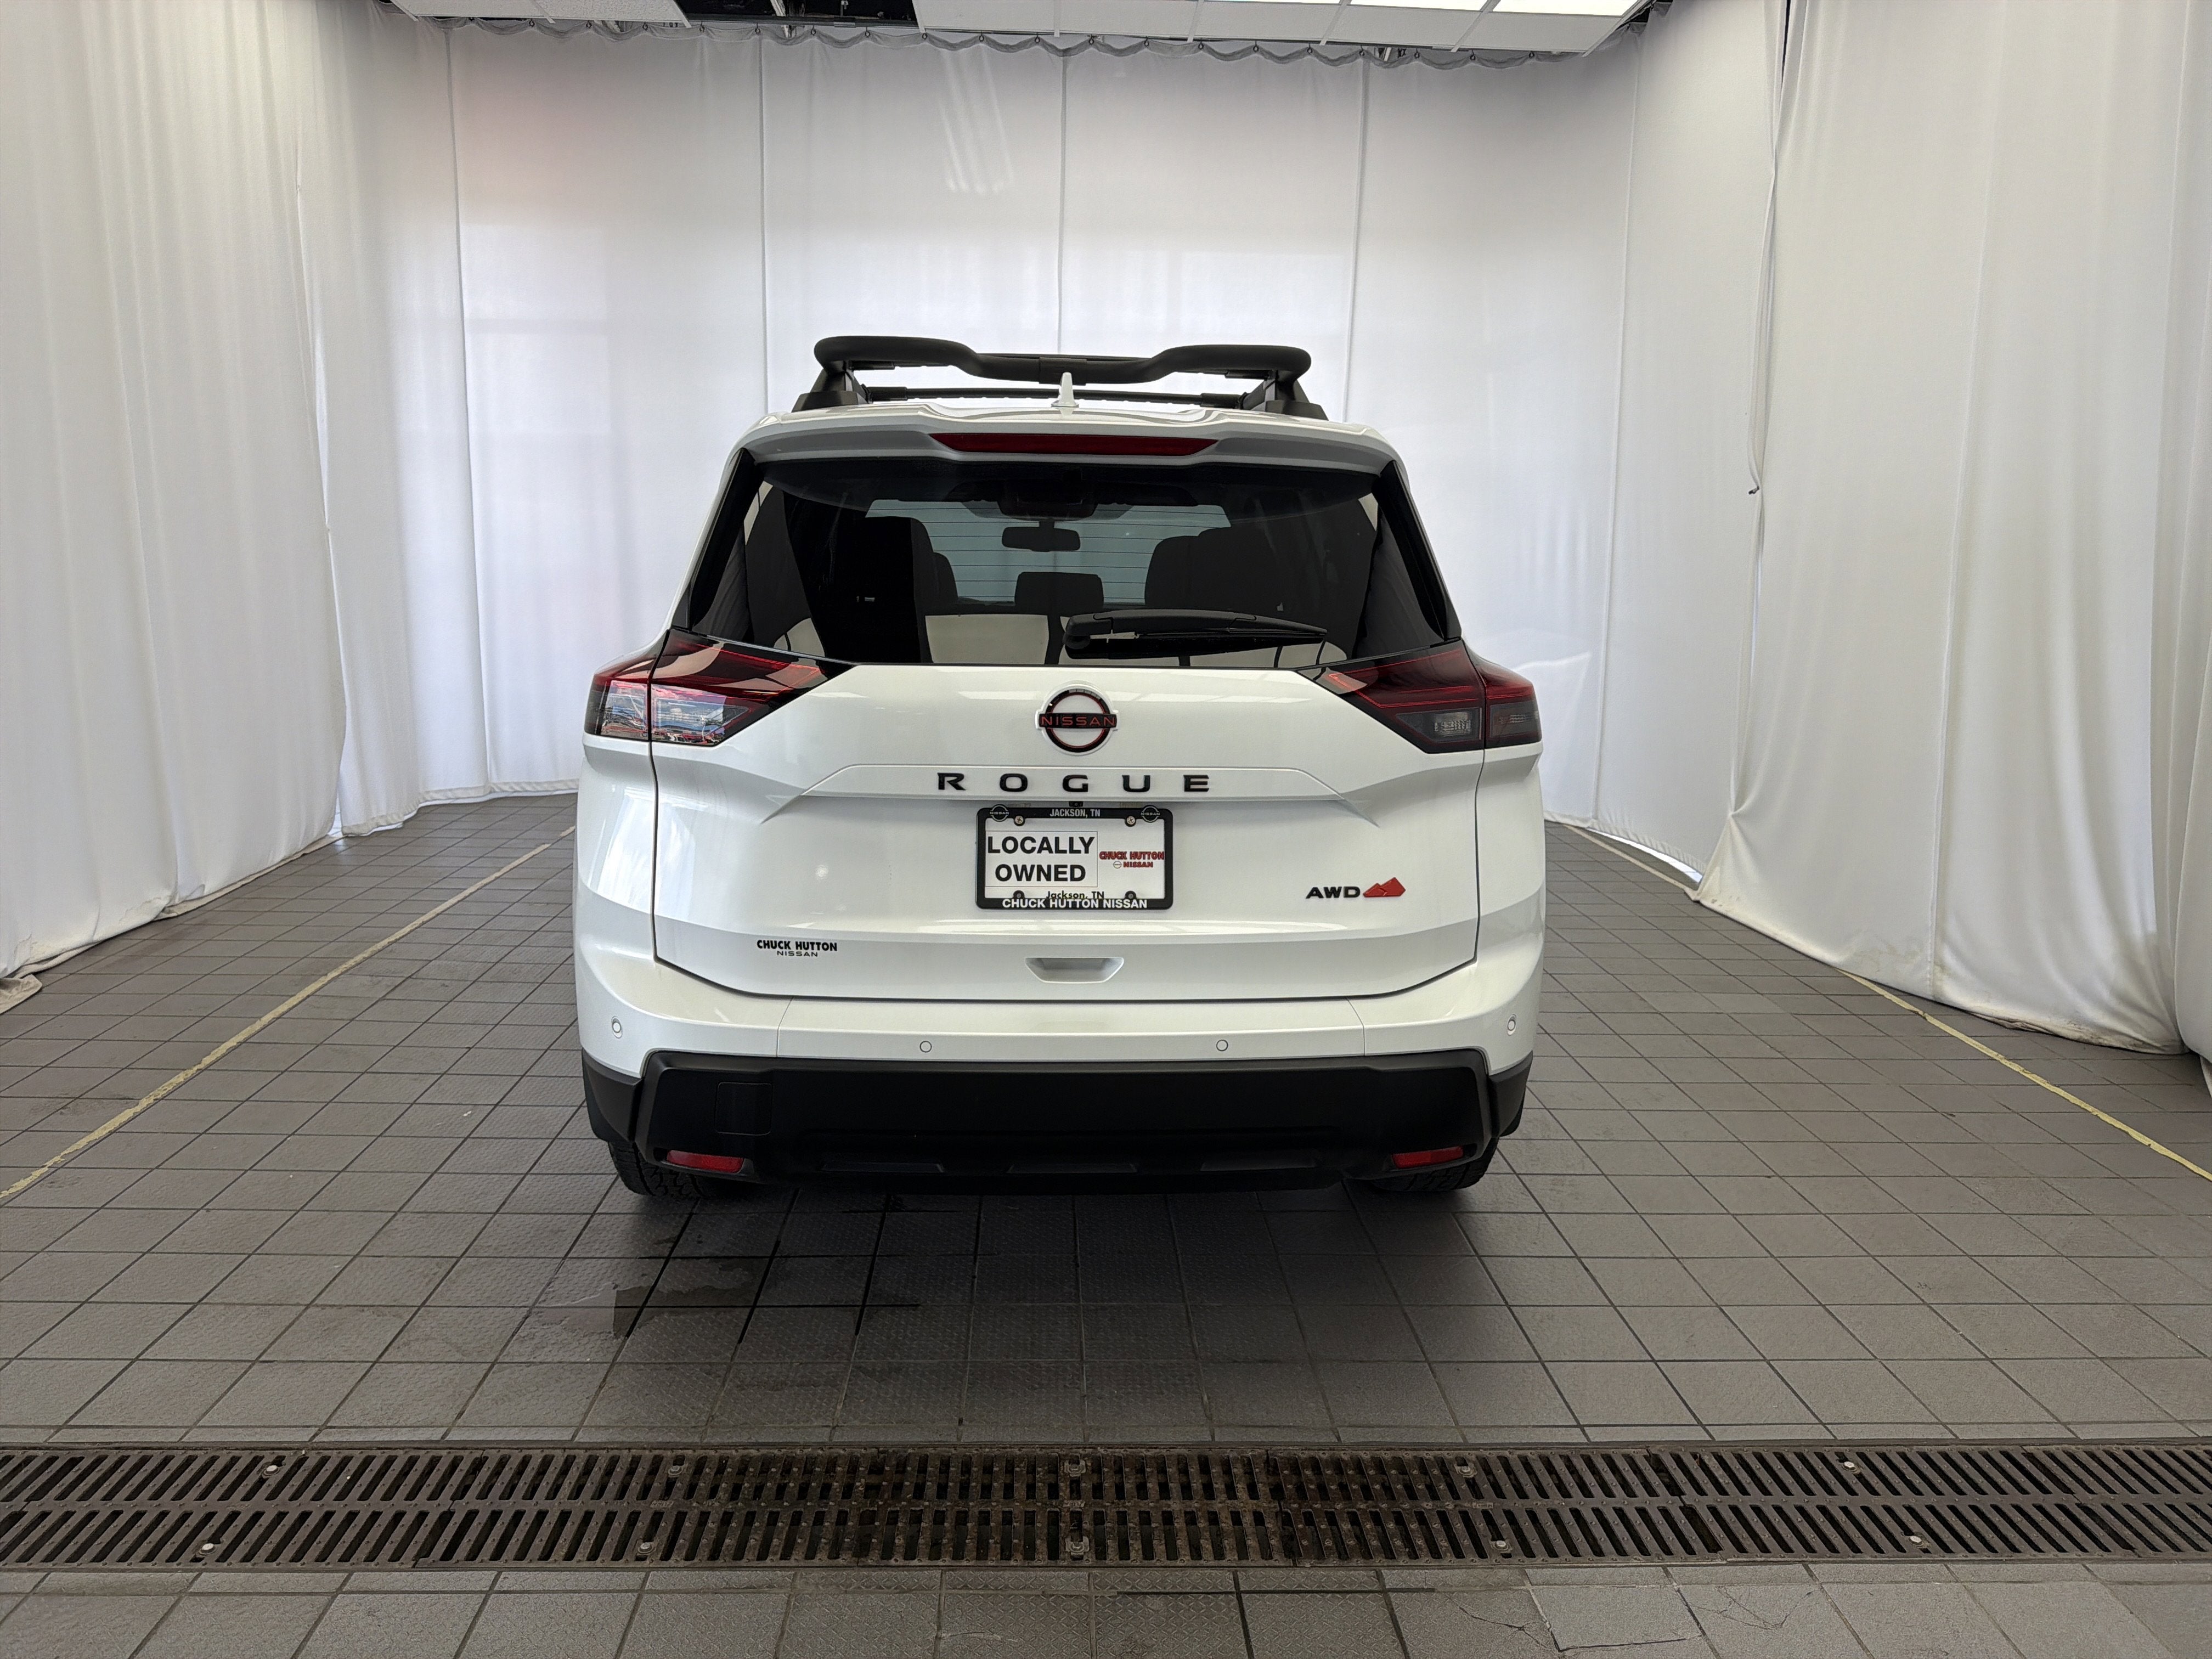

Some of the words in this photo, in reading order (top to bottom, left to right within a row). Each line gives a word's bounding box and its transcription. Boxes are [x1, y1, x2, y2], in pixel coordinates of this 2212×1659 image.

[1041, 716, 1115, 726] NISSAN
[936, 772, 1210, 793] ROGUE
[1049, 809, 1088, 818] JACKSON,
[1090, 809, 1101, 817] TN
[988, 836, 1095, 854] LOCALLY
[1099, 851, 1127, 860] CHUCK
[1129, 851, 1165, 860] HUTTON
[995, 864, 1086, 882] OWNED
[1046, 890, 1088, 899] Jackson,
[1092, 891, 1104, 899] TN
[1305, 886, 1361, 899] AWD
[1002, 899, 1046, 909] CHUCK
[1049, 899, 1099, 909] HUTTON
[1103, 899, 1147, 909] NISSAN
[757, 939, 792, 950] CHUCK
[795, 941, 838, 951] HUTTON
